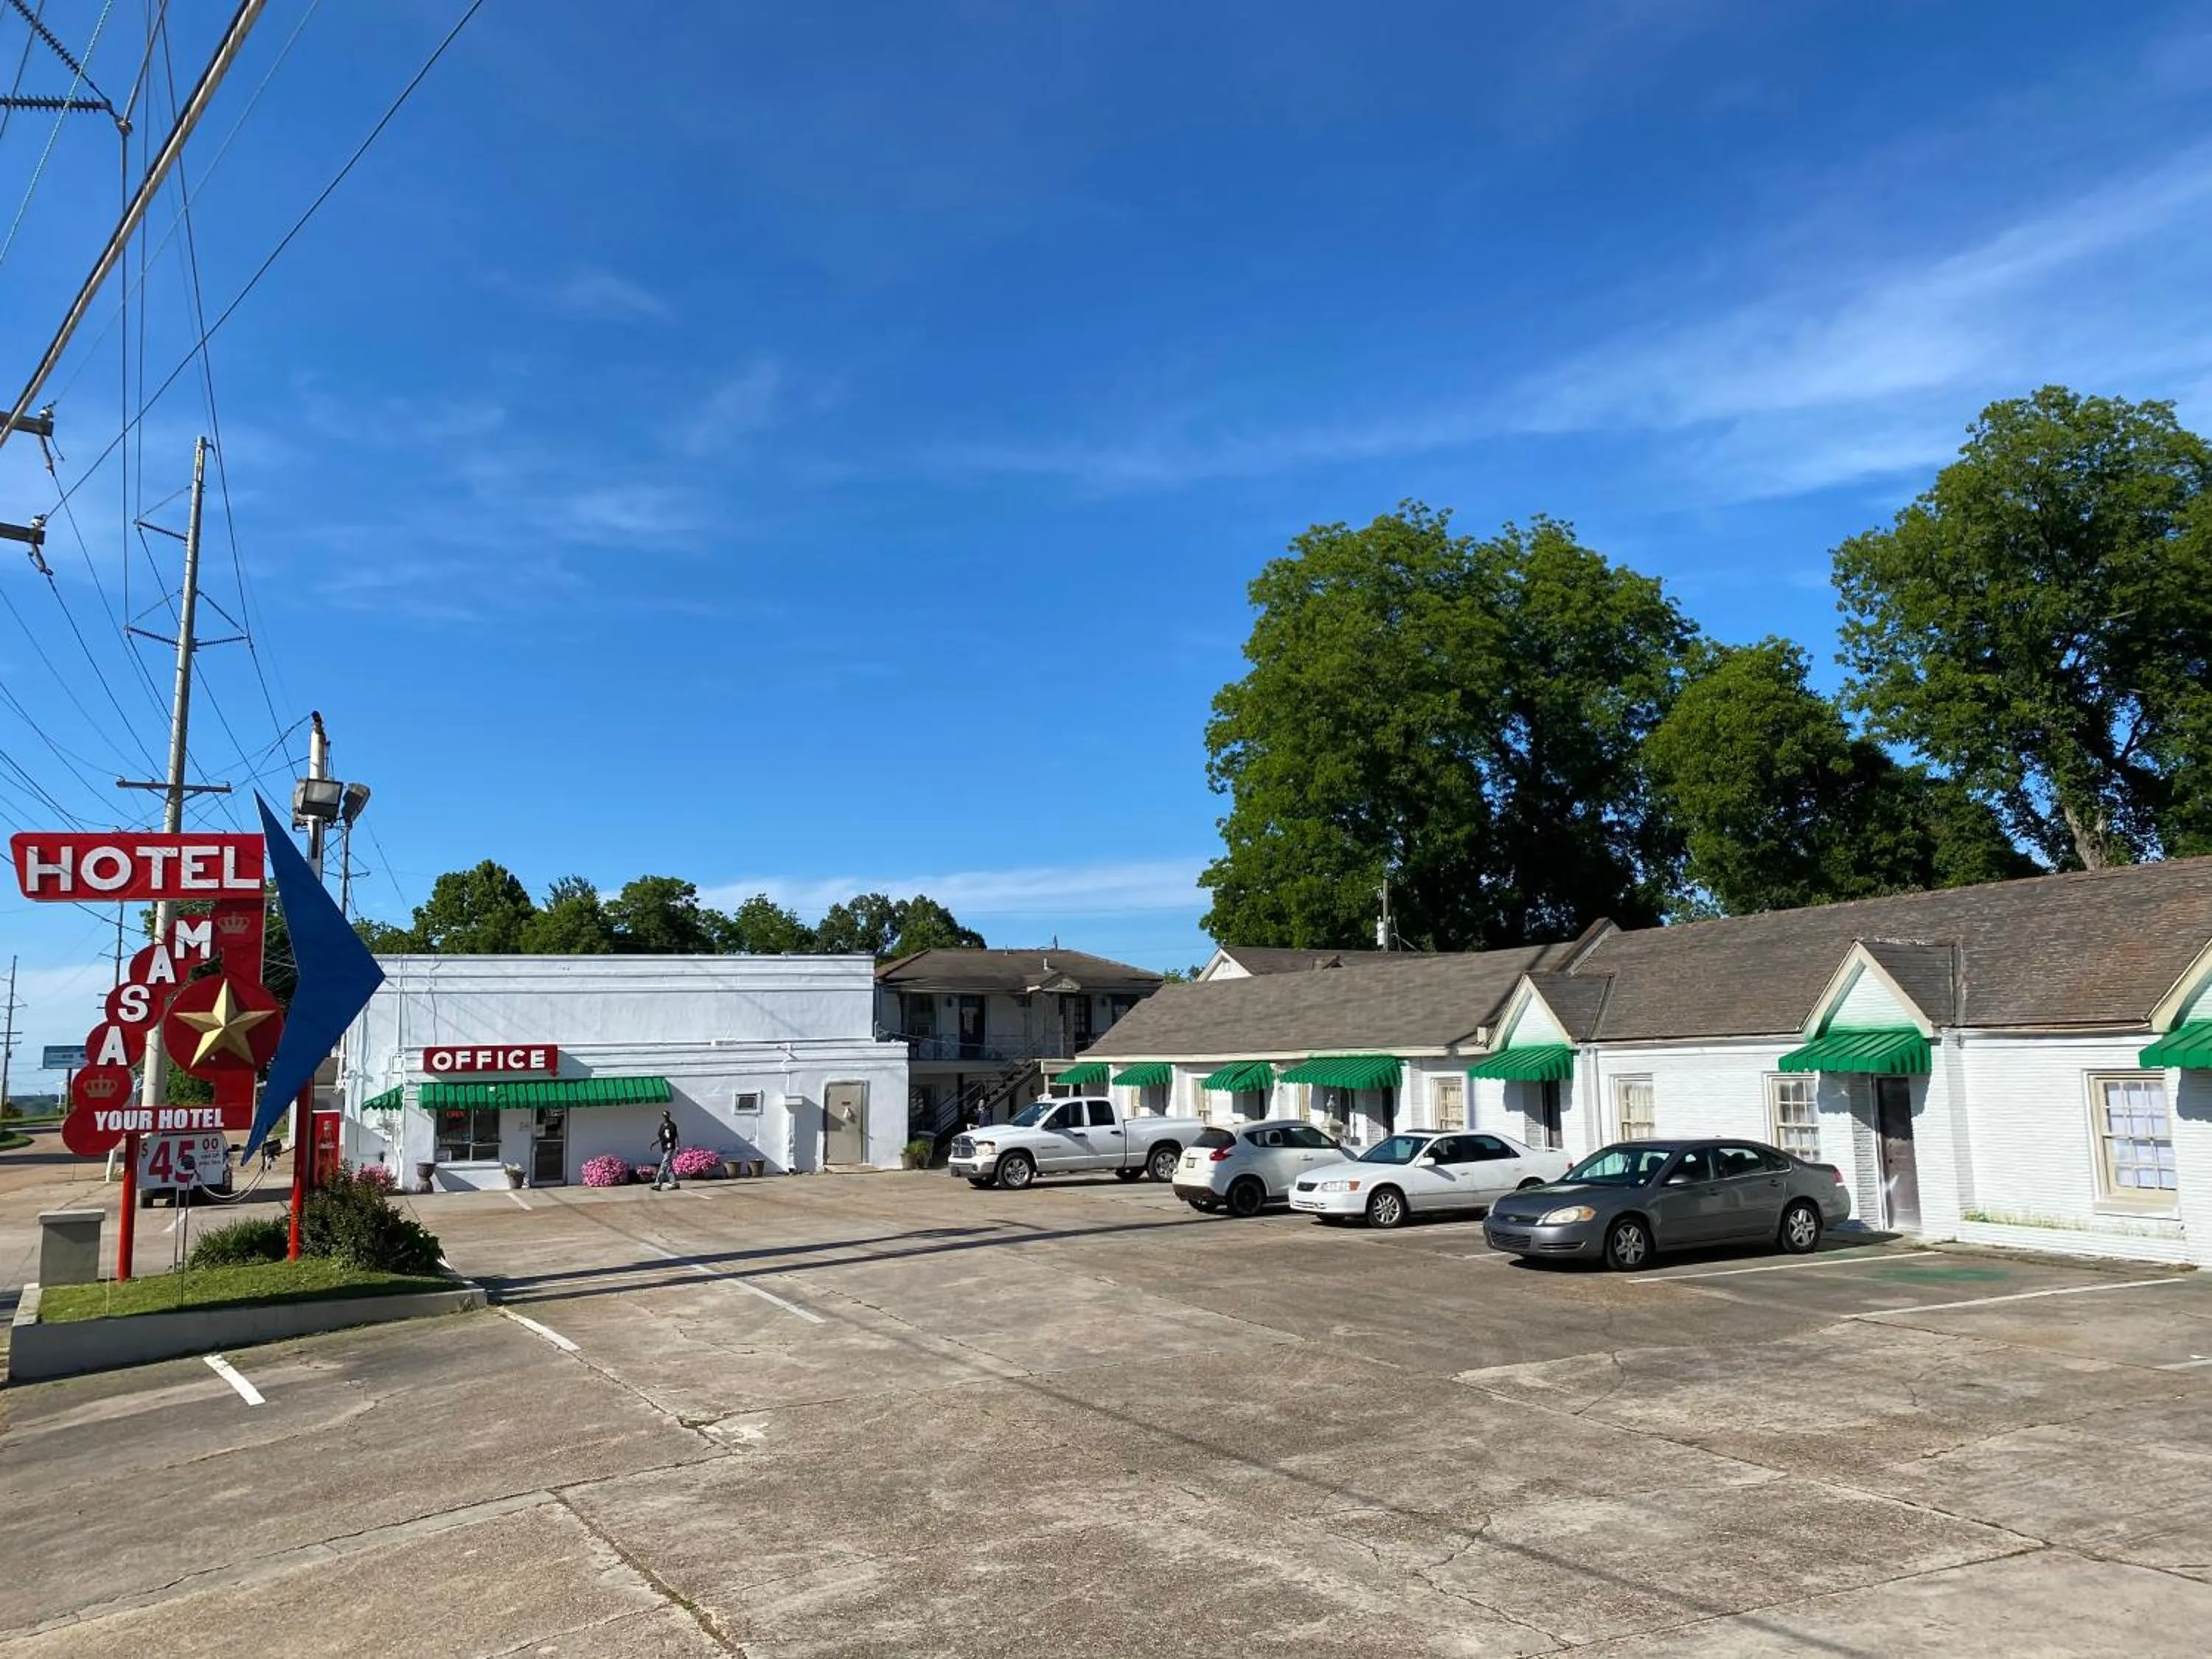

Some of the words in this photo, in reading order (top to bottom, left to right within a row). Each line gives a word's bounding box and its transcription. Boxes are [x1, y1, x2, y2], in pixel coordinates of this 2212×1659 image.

[27, 846, 260, 891] HOTEL
[432, 1050, 545, 1071] OFFICE
[94, 1110, 153, 1131] YOUR
[159, 1108, 224, 1130] HOTEL
